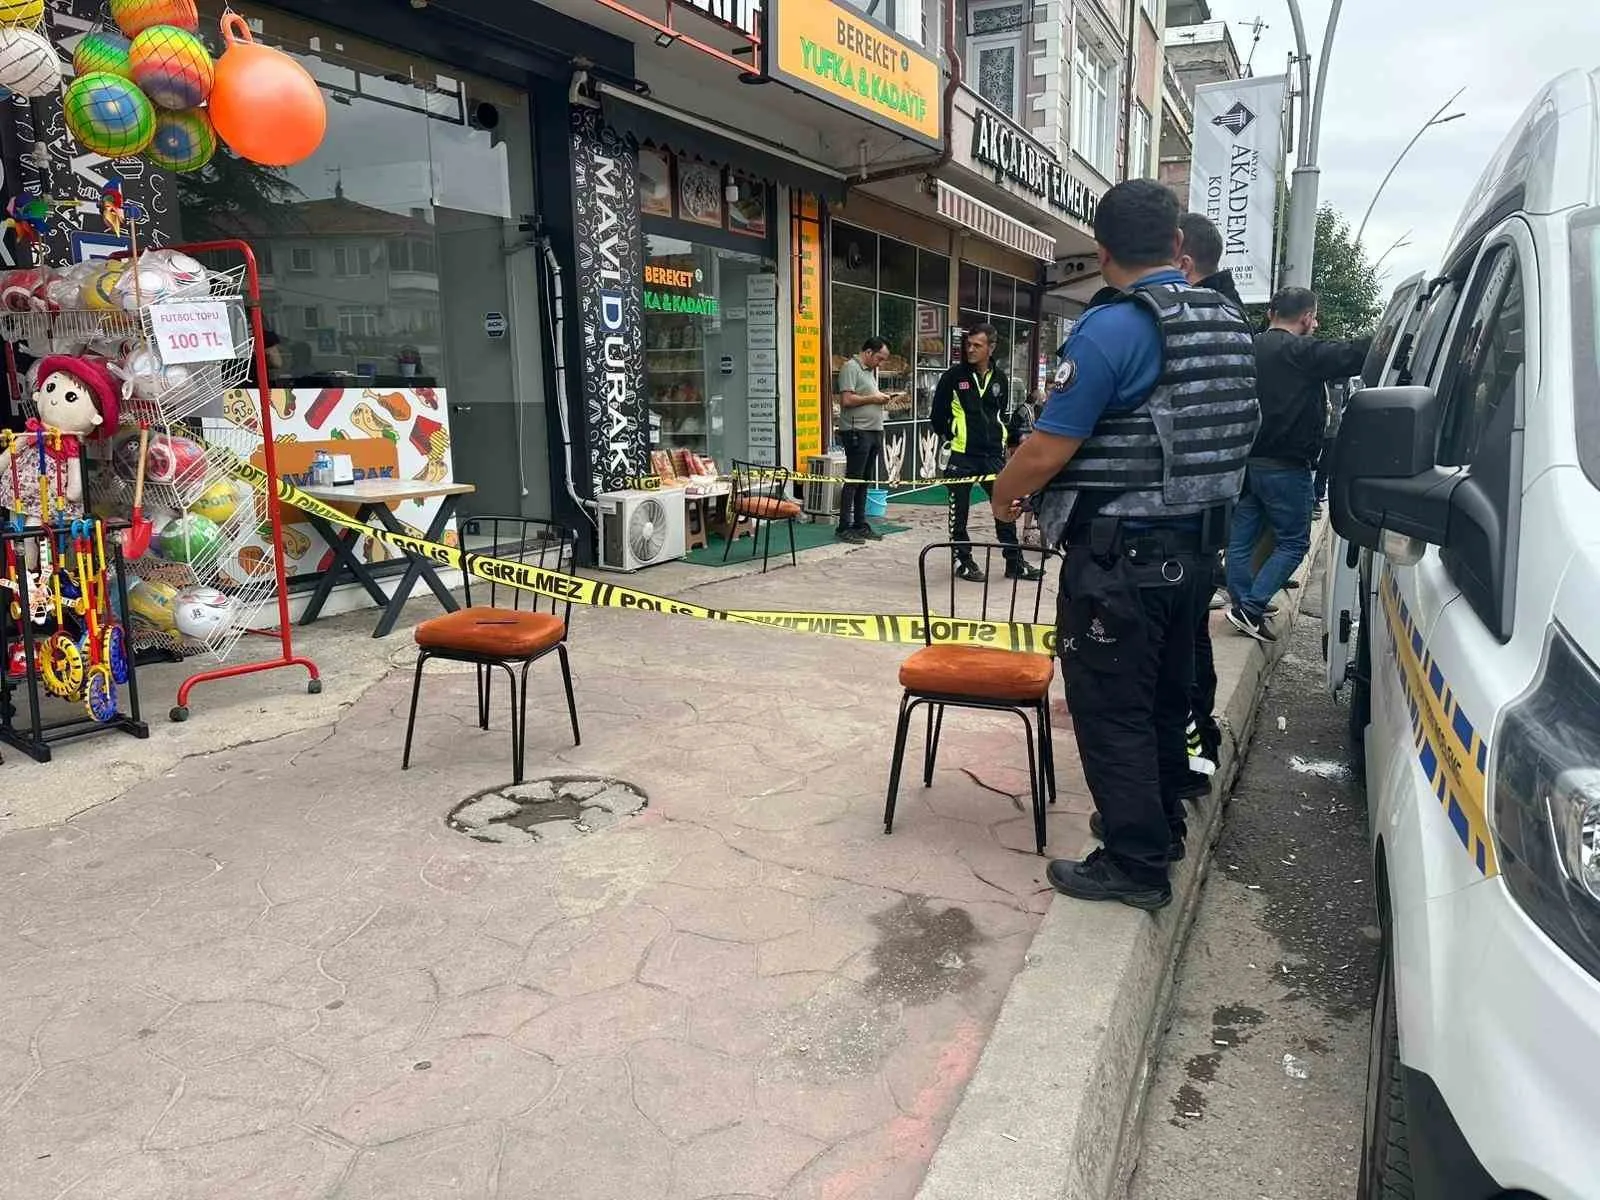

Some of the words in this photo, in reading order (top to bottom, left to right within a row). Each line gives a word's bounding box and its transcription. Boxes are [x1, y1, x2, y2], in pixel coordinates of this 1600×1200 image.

[800, 36, 855, 87] YUFKA
[858, 66, 869, 97] &
[837, 17, 898, 73] BEREKET
[978, 112, 1050, 200] AKÇAABAT
[1052, 164, 1087, 218] EKMEK
[1225, 143, 1250, 256] AKADEMİ
[644, 265, 694, 288] BEREKET
[160, 312, 195, 323] FUTBOL
[196, 311, 219, 321] TOPU
[168, 333, 199, 350] 100
[202, 332, 223, 347] TL
[602, 295, 631, 473] DURAK
